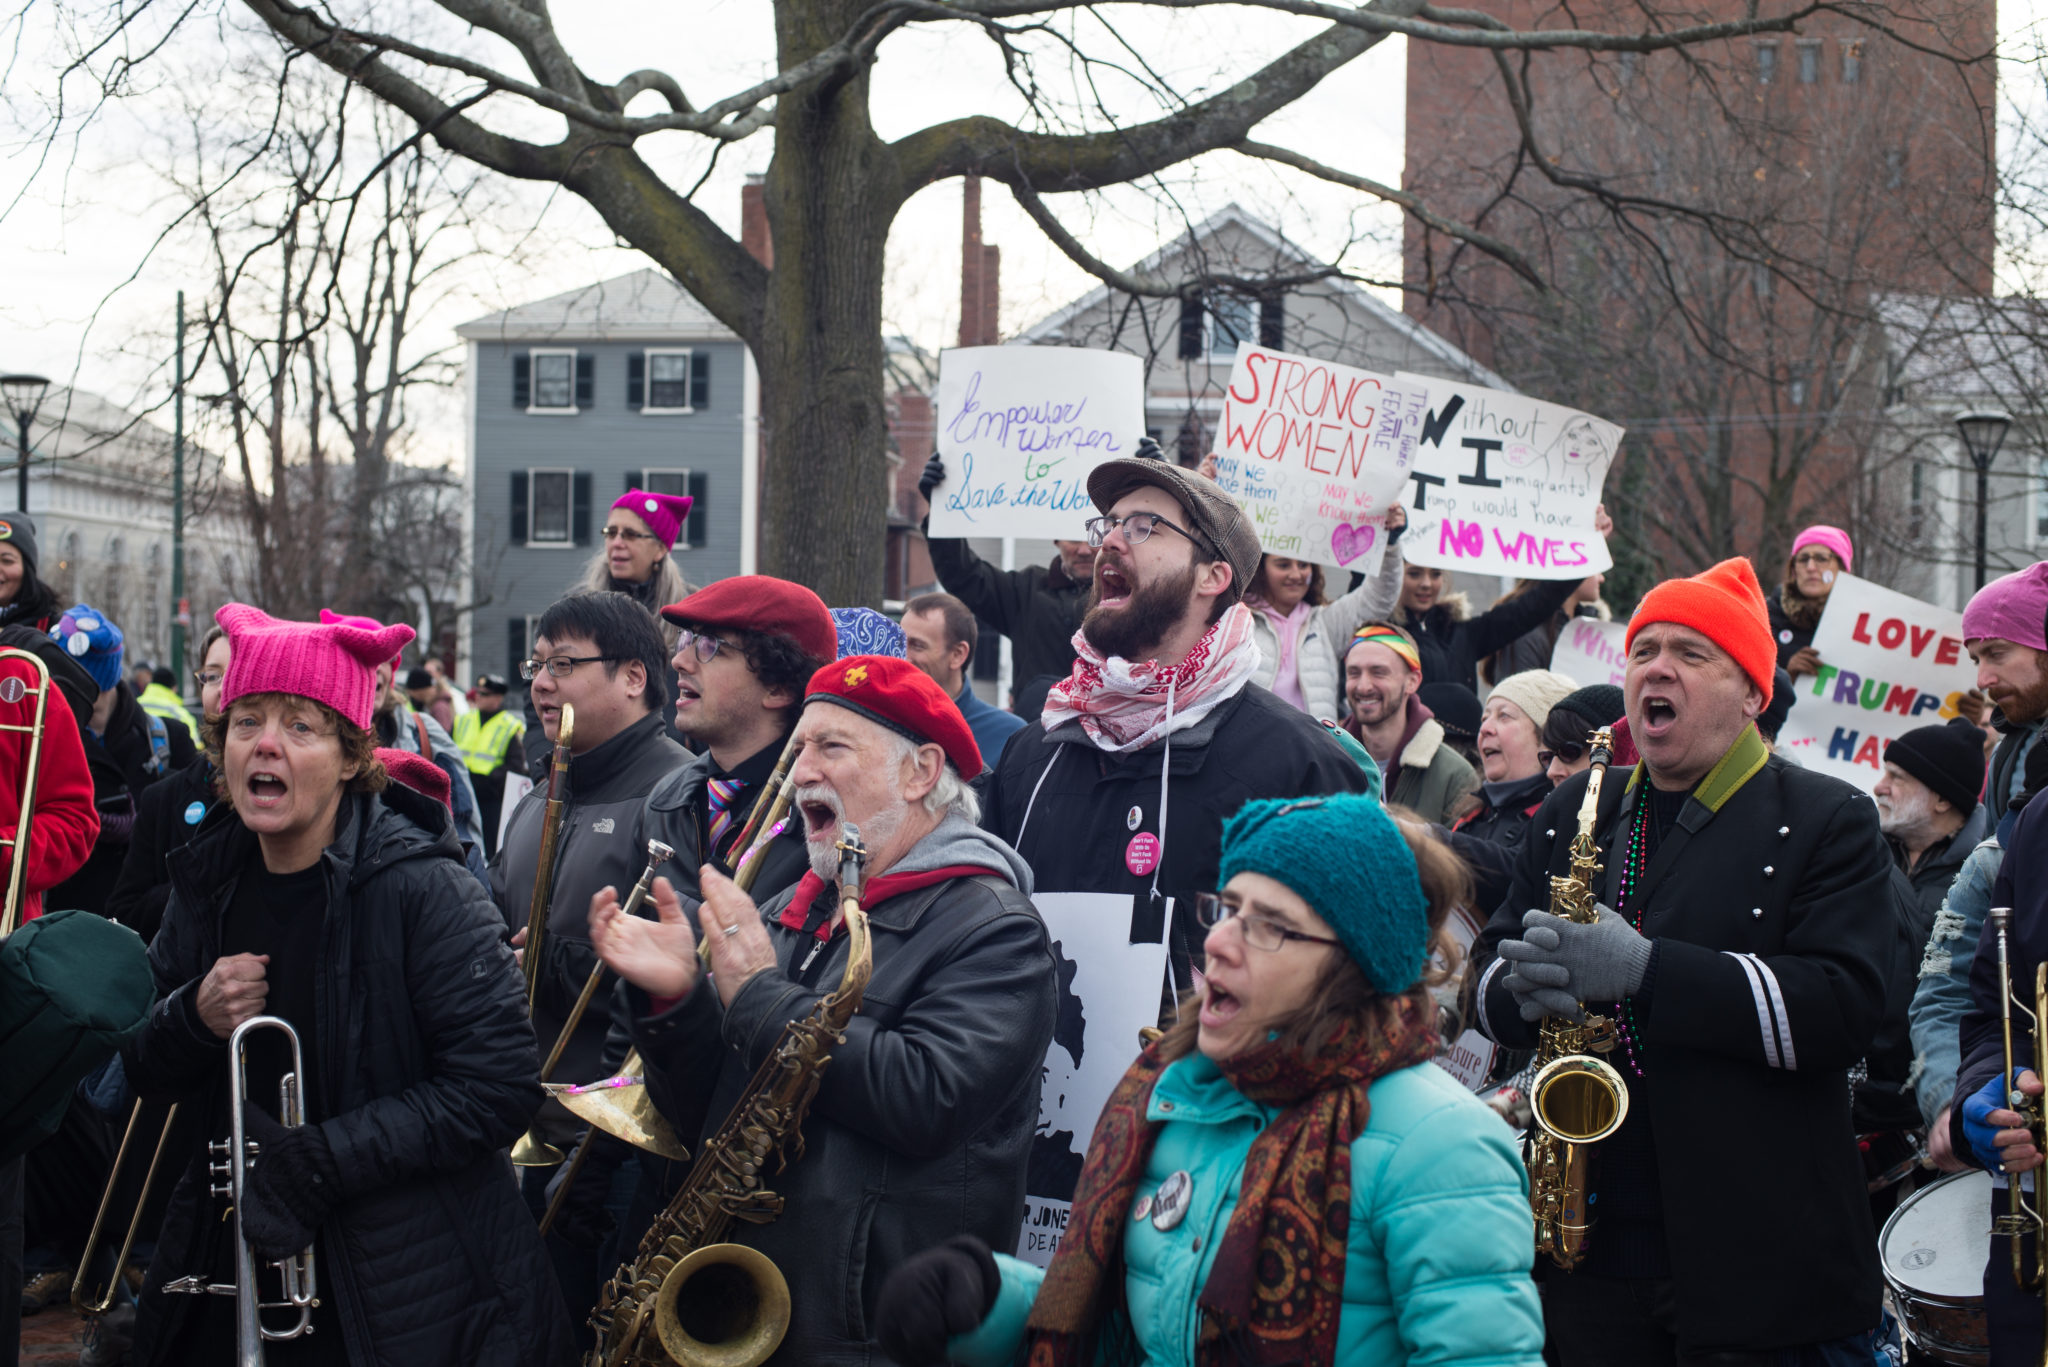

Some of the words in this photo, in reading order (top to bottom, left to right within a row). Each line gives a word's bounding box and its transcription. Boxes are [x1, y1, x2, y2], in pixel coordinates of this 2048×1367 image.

[945, 370, 1088, 449] Empower
[1229, 352, 1381, 429] STRONG
[1405, 388, 1428, 427] The
[1017, 426, 1121, 456] Women
[1226, 399, 1370, 480] WOMEN
[1372, 390, 1402, 451] FEMALE
[1420, 394, 1548, 449] Without
[945, 452, 1008, 523] Save
[1010, 482, 1051, 507] the
[1050, 477, 1091, 511] Wor
[1025, 455, 1067, 482] to
[1244, 482, 1278, 503] them
[1409, 470, 1457, 518] Trump
[1472, 496, 1518, 518] would
[1531, 502, 1578, 528] have
[1260, 527, 1302, 554] them
[1356, 510, 1385, 528] them
[1438, 518, 1484, 558] NO
[1852, 612, 1962, 666] LOVE
[1812, 663, 1962, 721] TRUMPS
[1827, 725, 1892, 770] HA
[1032, 1205, 1070, 1230] JONE
[1028, 1231, 1062, 1253] DEA
